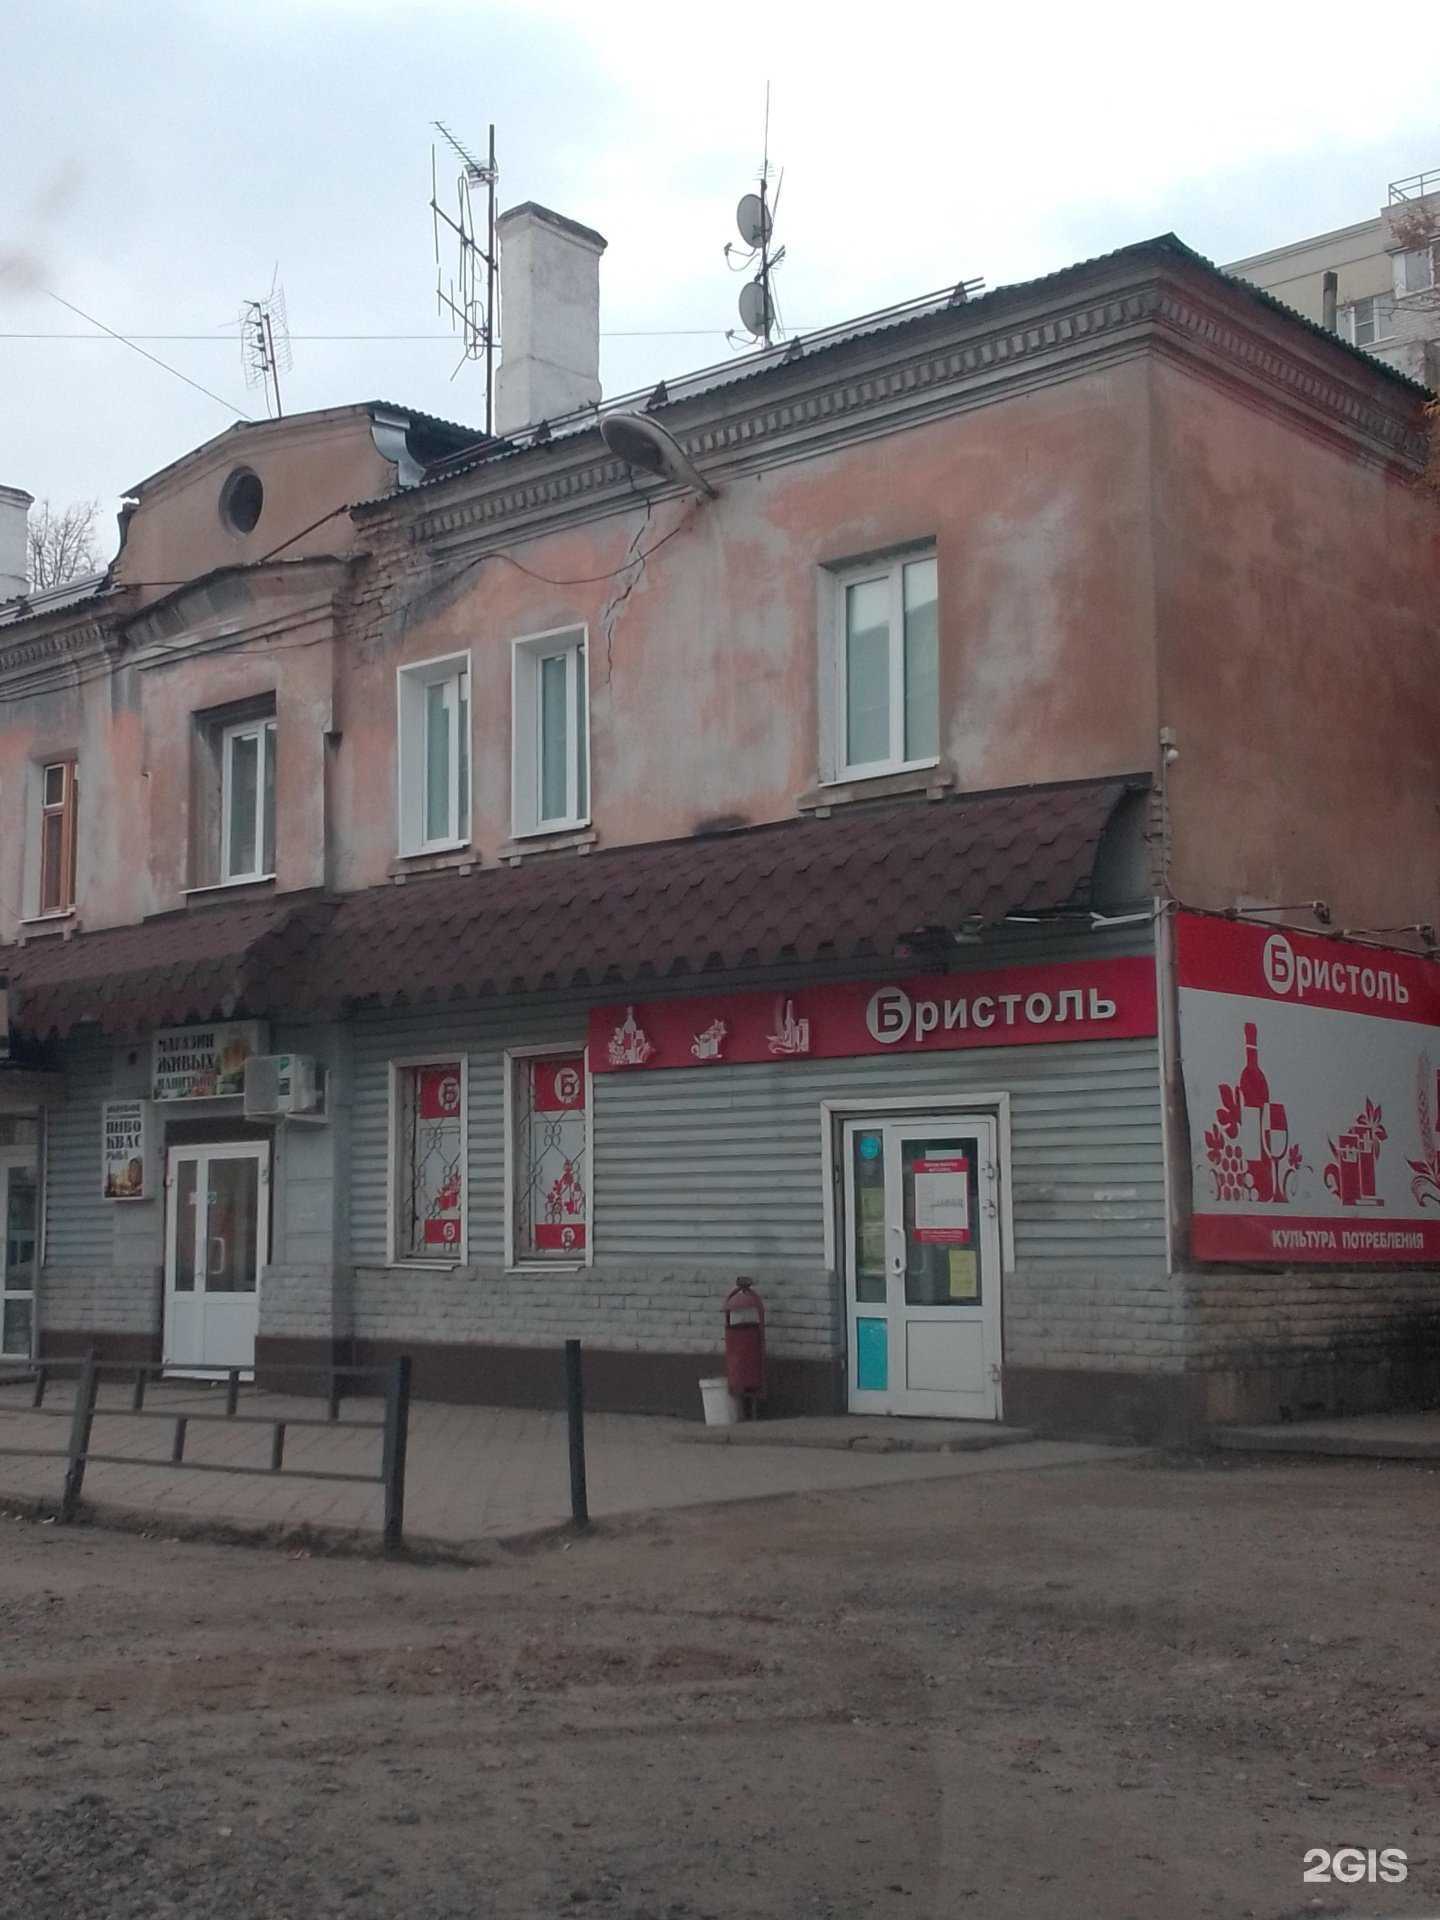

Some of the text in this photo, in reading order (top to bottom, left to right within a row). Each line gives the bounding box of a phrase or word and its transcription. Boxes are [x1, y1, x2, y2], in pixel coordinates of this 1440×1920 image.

[1264, 934, 1409, 1004] Бристоль
[866, 987, 1116, 1044] Бристоль
[158, 1033, 215, 1053] МАГАЗИН
[156, 1053, 215, 1074] ЖИВЫХ
[557, 1070, 579, 1100] Б
[106, 1121, 141, 1134] ПИВО
[106, 1135, 143, 1150] КВАС
[1272, 1230, 1424, 1249] КУЛЬТУРА ПОТРЕБЛЕНИЯ
